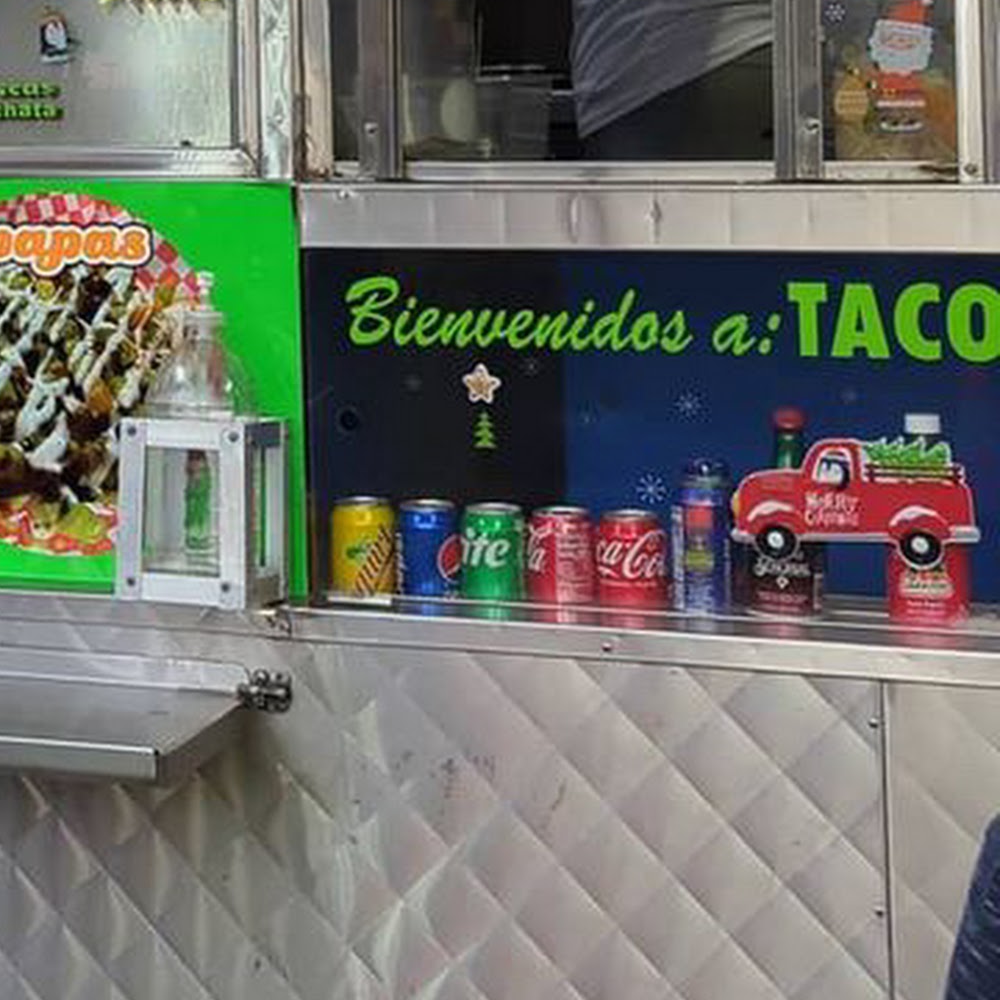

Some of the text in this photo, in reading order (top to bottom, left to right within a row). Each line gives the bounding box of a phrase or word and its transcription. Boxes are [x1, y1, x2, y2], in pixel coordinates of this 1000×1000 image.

[345, 275, 1000, 364] Bienvenidos a: TACO
